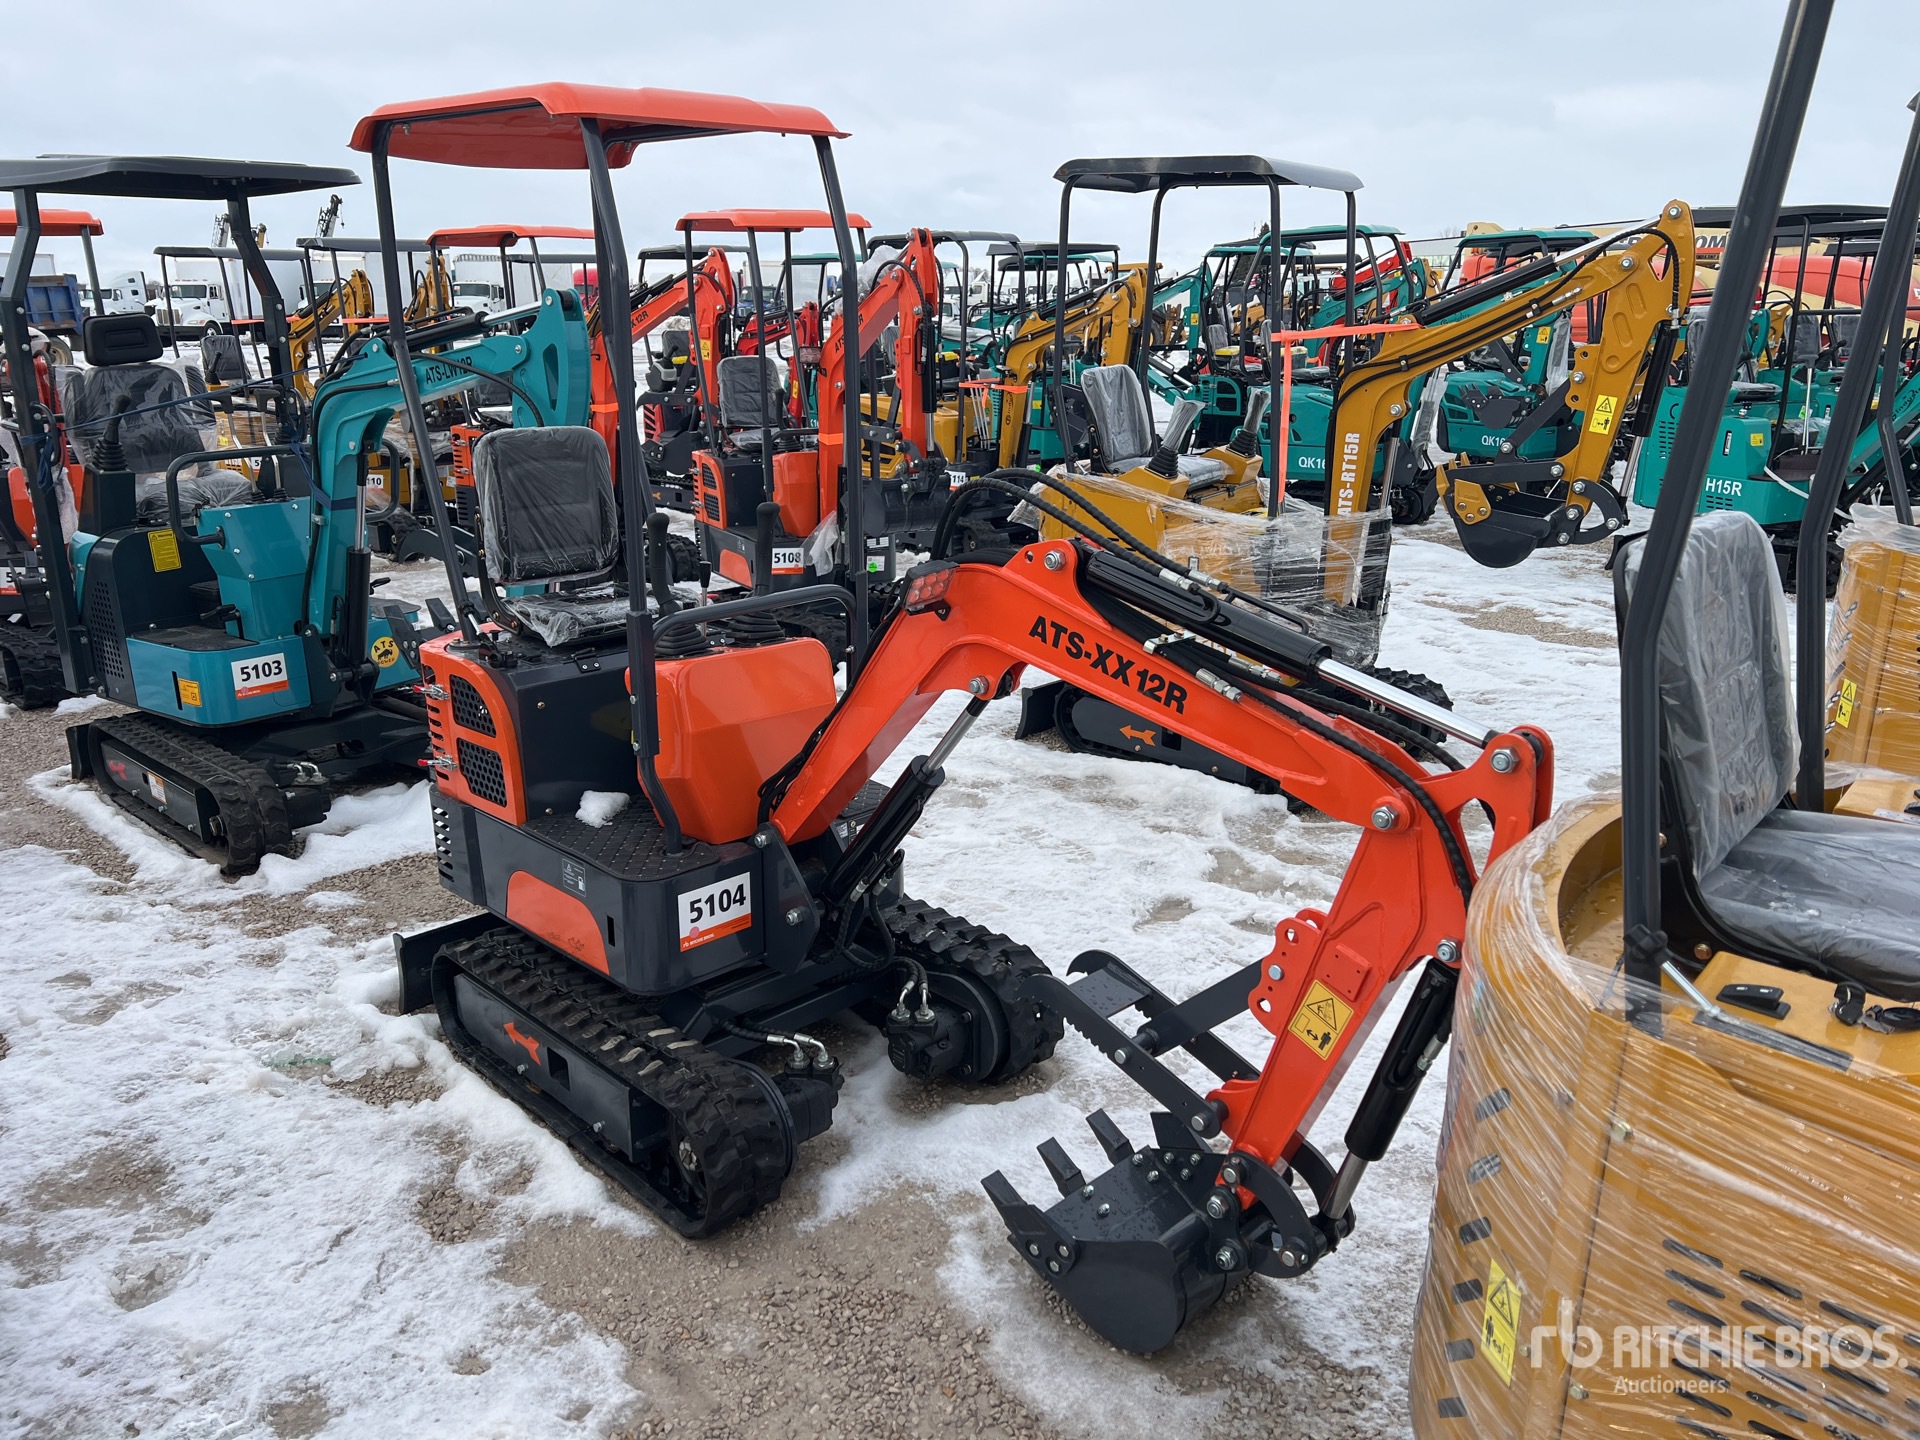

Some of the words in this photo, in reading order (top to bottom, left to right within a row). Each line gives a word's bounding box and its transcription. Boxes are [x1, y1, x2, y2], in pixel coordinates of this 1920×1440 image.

[1337, 432, 1360, 517] ATS-RT15R
[773, 552, 802, 564] 5108
[373, 640, 394, 653] ATS
[240, 660, 283, 682] 5103
[689, 883, 747, 924] 5104
